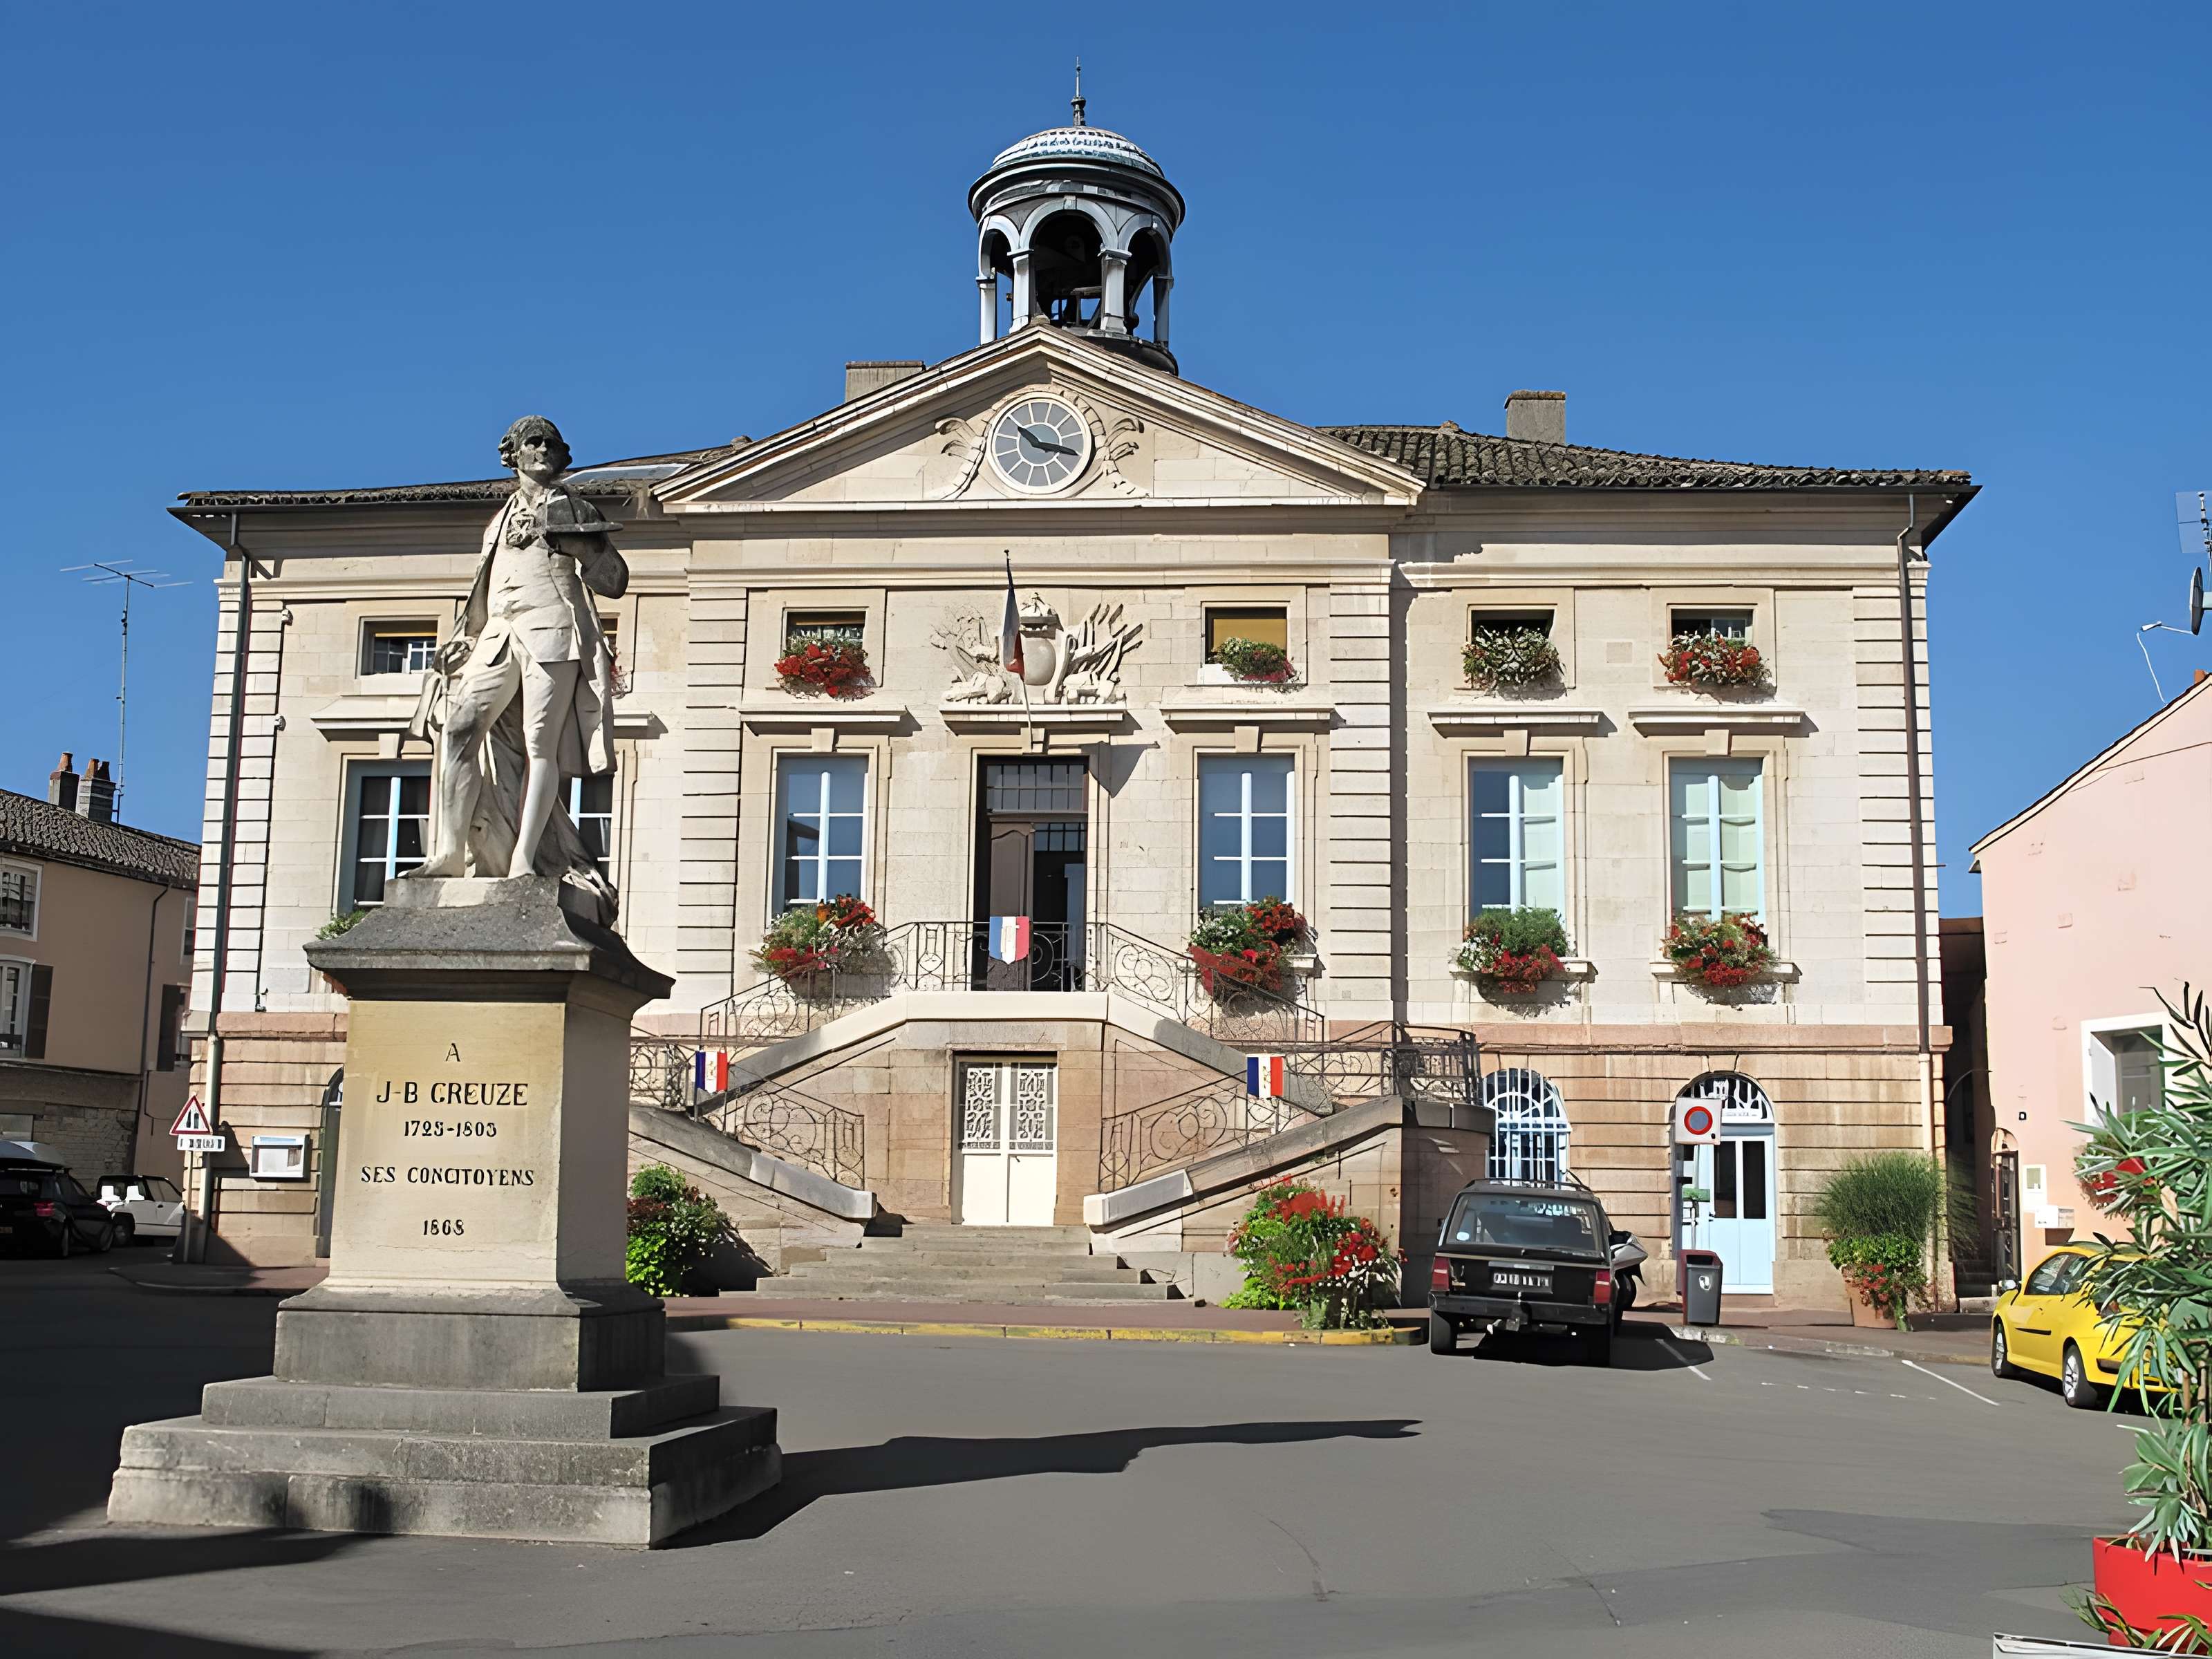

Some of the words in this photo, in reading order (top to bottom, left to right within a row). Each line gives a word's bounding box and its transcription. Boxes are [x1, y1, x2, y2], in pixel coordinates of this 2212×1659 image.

[445, 1042, 461, 1062] A
[361, 1166, 396, 1183] SES
[406, 1167, 535, 1186] CONCITOYENS
